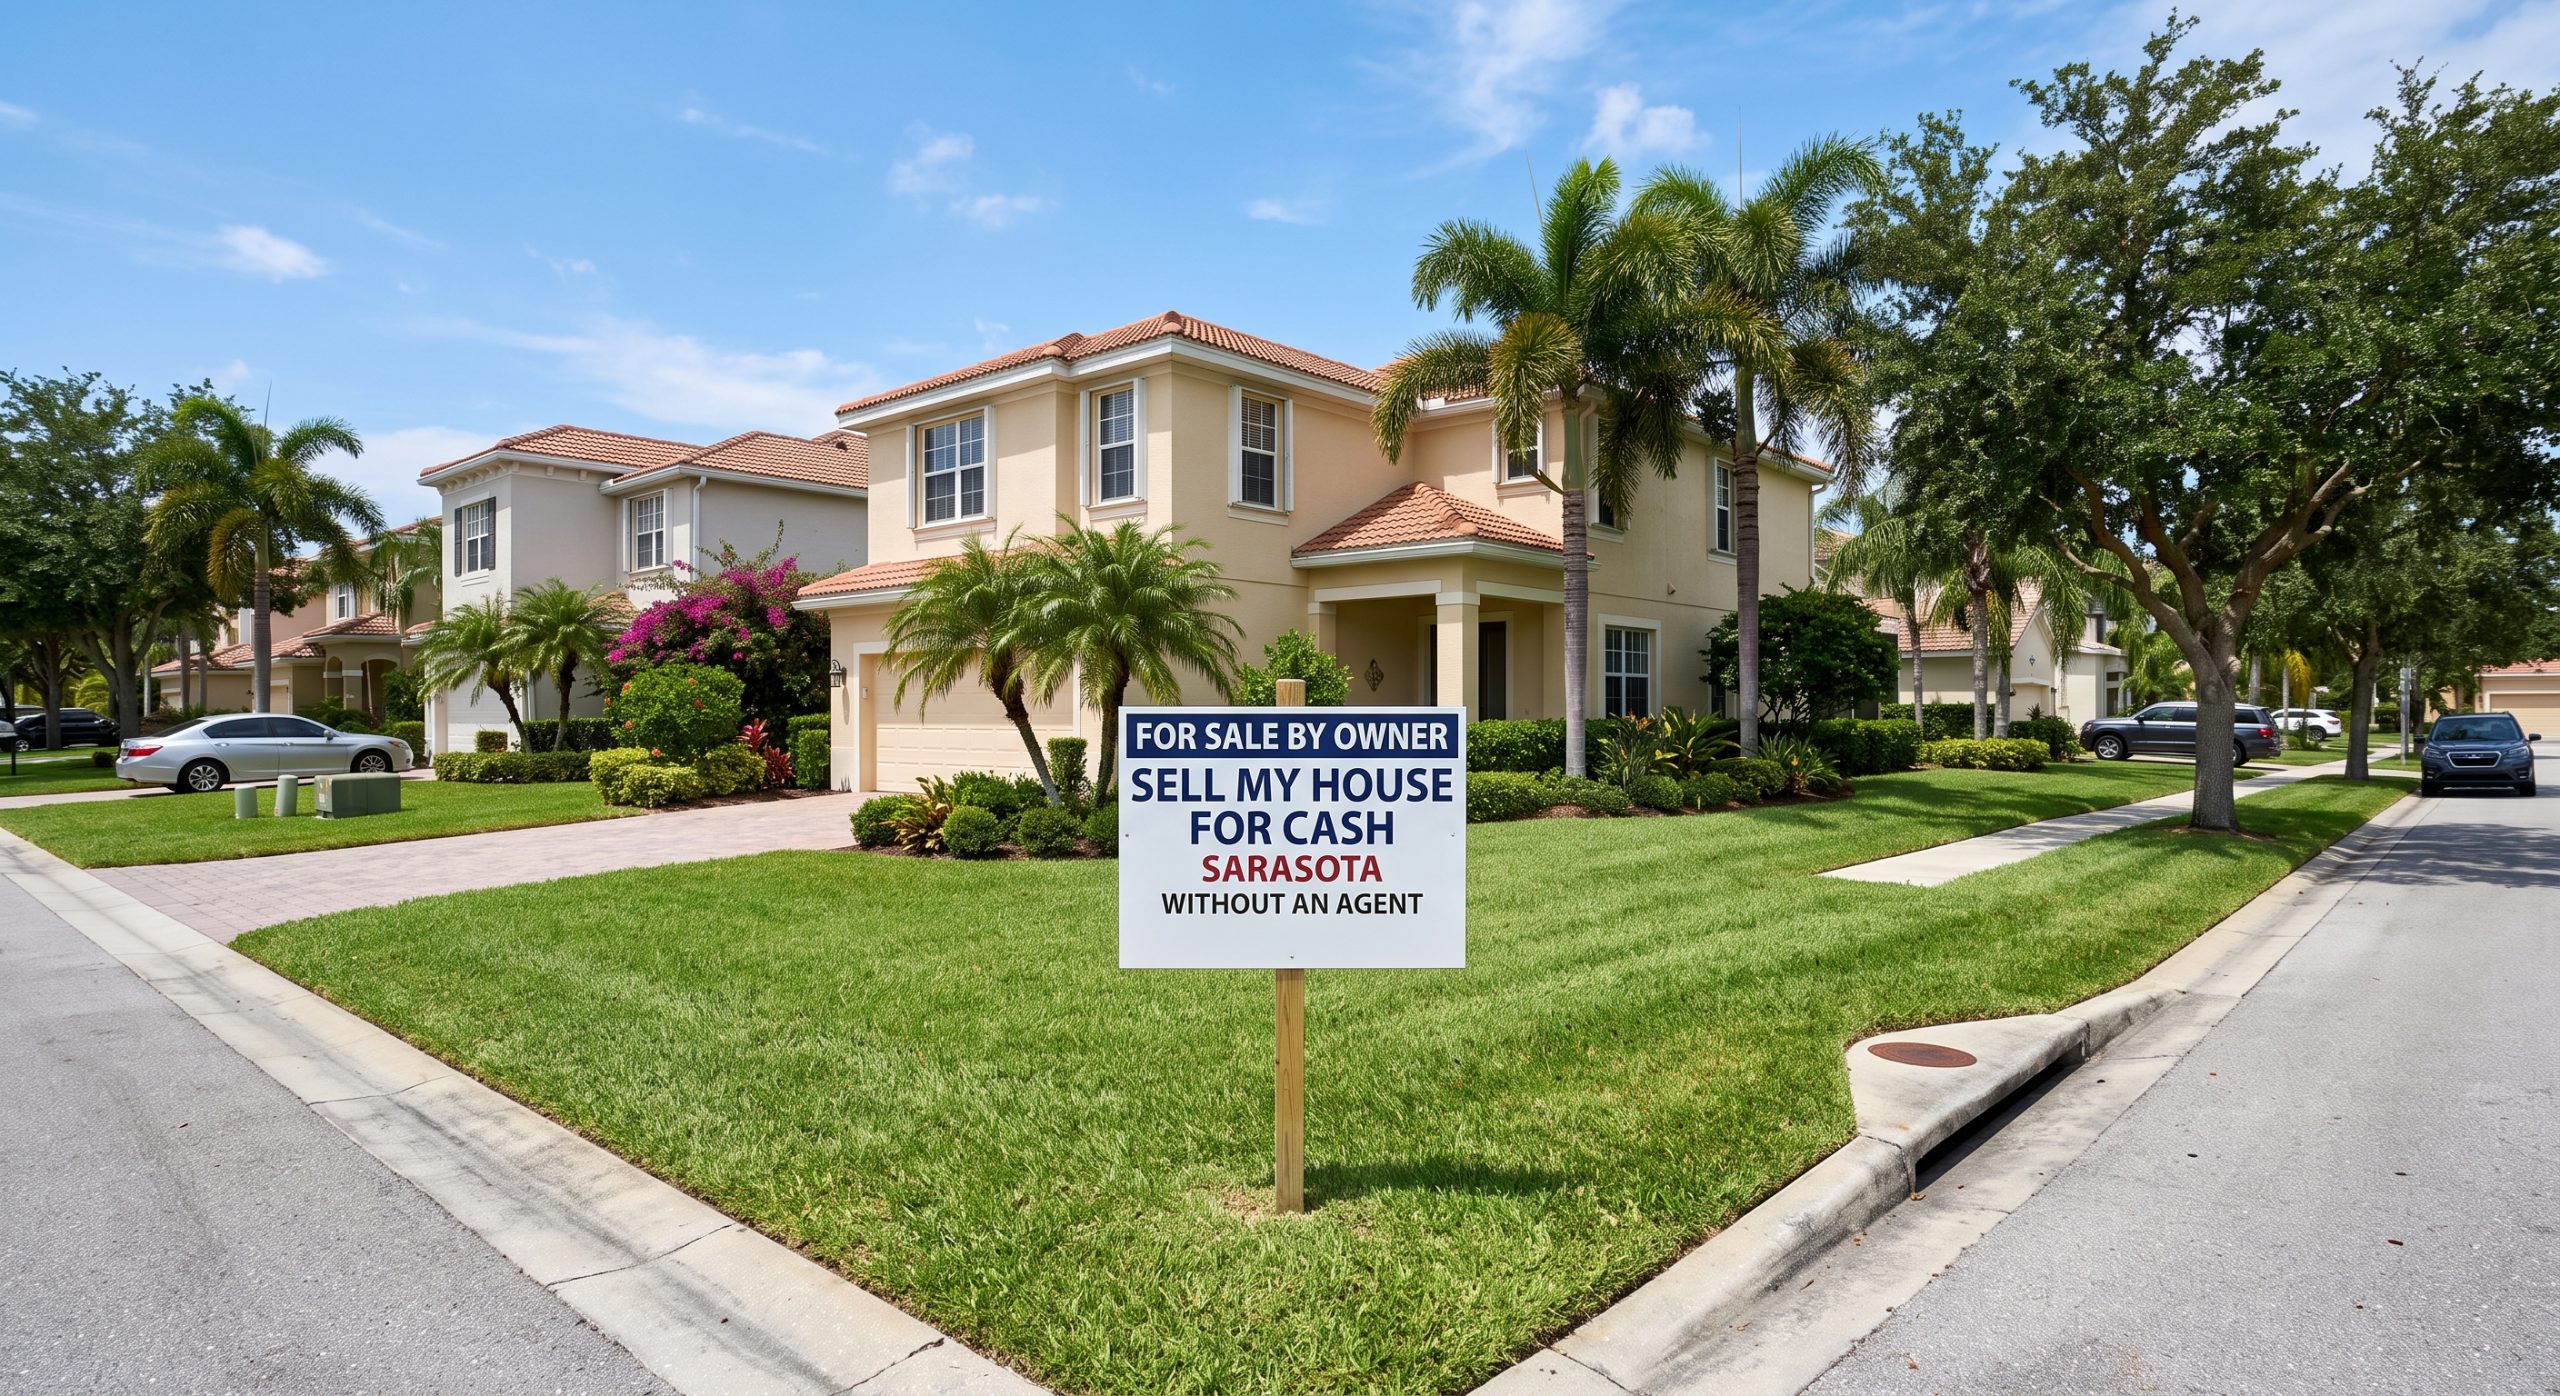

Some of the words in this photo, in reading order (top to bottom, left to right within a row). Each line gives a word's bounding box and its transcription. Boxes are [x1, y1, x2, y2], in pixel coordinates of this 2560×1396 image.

[1136, 722, 1197, 750] FOR
[1204, 722, 1279, 750] SALE
[1287, 722, 1327, 750] BY
[1333, 722, 1448, 750] OWNER
[1131, 767, 1226, 803] SELL
[1236, 767, 1302, 803] MY
[1312, 767, 1453, 803] HOUSE
[1190, 810, 1273, 846] FOR
[1282, 810, 1394, 846] CASH
[1202, 854, 1383, 883] SARASOTA
[1161, 892, 1286, 915] WITHOUT
[1291, 892, 1329, 915] AN
[1335, 892, 1424, 915] AGENT
